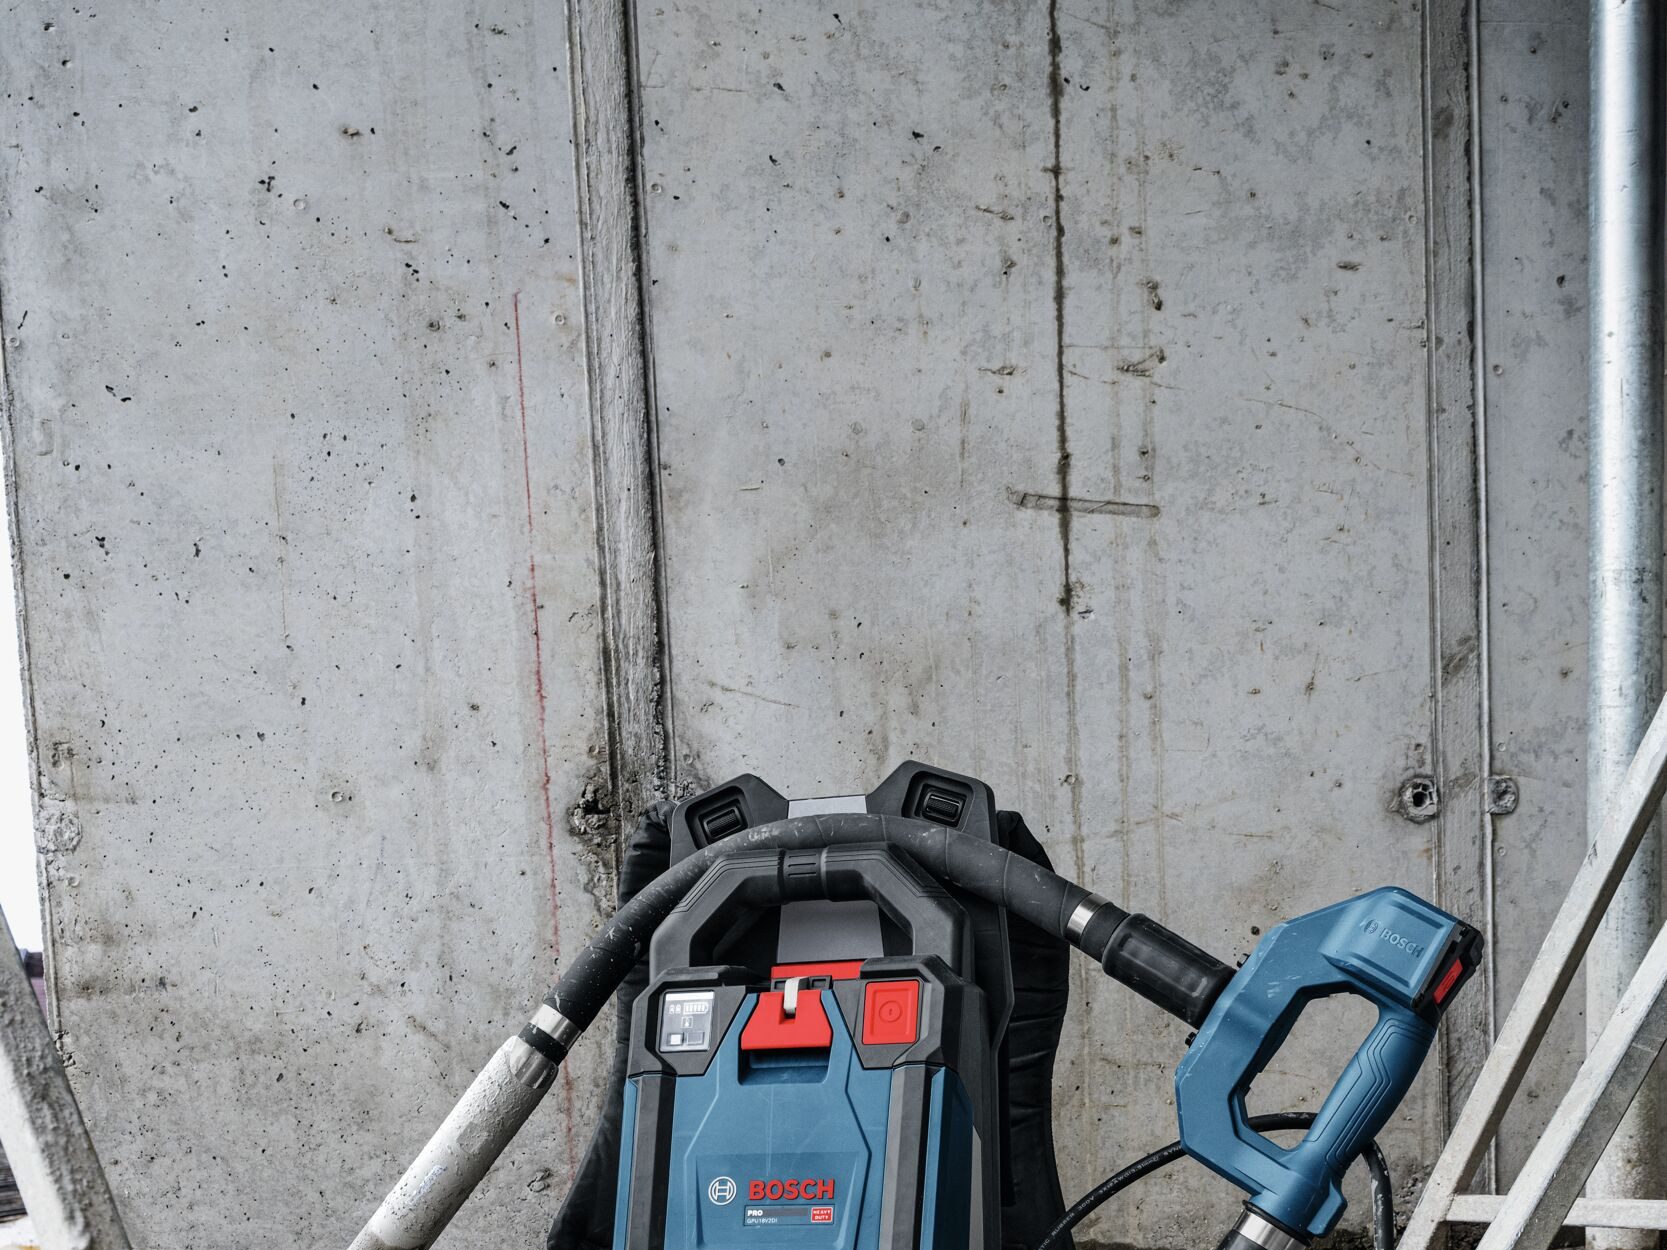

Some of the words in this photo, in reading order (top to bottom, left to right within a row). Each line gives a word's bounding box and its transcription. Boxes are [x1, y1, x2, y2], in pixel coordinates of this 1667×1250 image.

[1380, 928, 1424, 958] BOSCH
[748, 1179, 835, 1200] BOSCH
[747, 1209, 763, 1217] PRO
